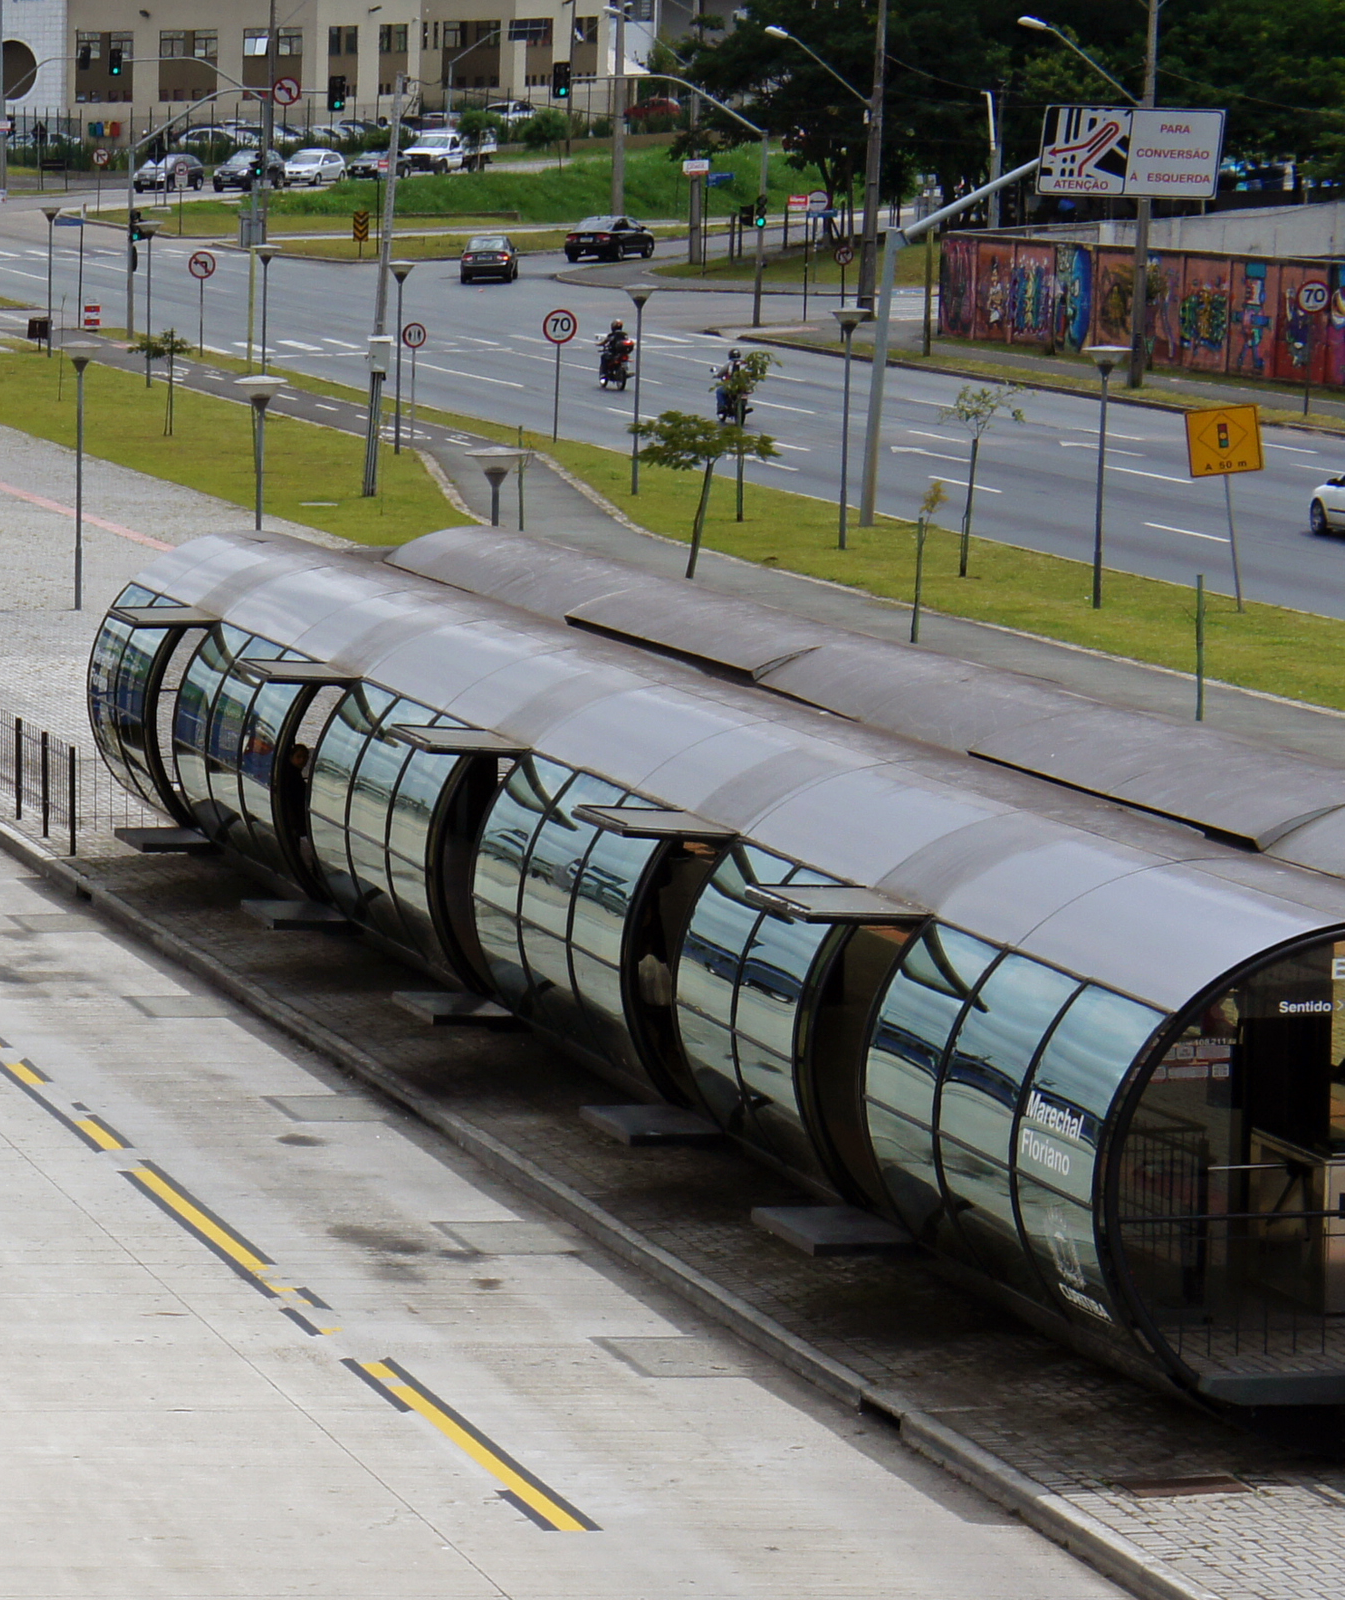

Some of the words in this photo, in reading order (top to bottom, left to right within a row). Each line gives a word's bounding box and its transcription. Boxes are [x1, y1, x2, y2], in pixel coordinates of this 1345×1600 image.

[1160, 124, 1191, 134] PARA
[1136, 147, 1210, 160] CONVERSÃO
[1053, 178, 1109, 191] ATENÇÃO
[1147, 172, 1210, 184] ESQUERDA
[1304, 288, 1326, 303] 70
[551, 317, 571, 332] 70
[1205, 463, 1213, 471] A
[1279, 1001, 1332, 1014] Sentido
[1026, 1090, 1085, 1141] Marechal
[1021, 1127, 1070, 1176] Floriano
